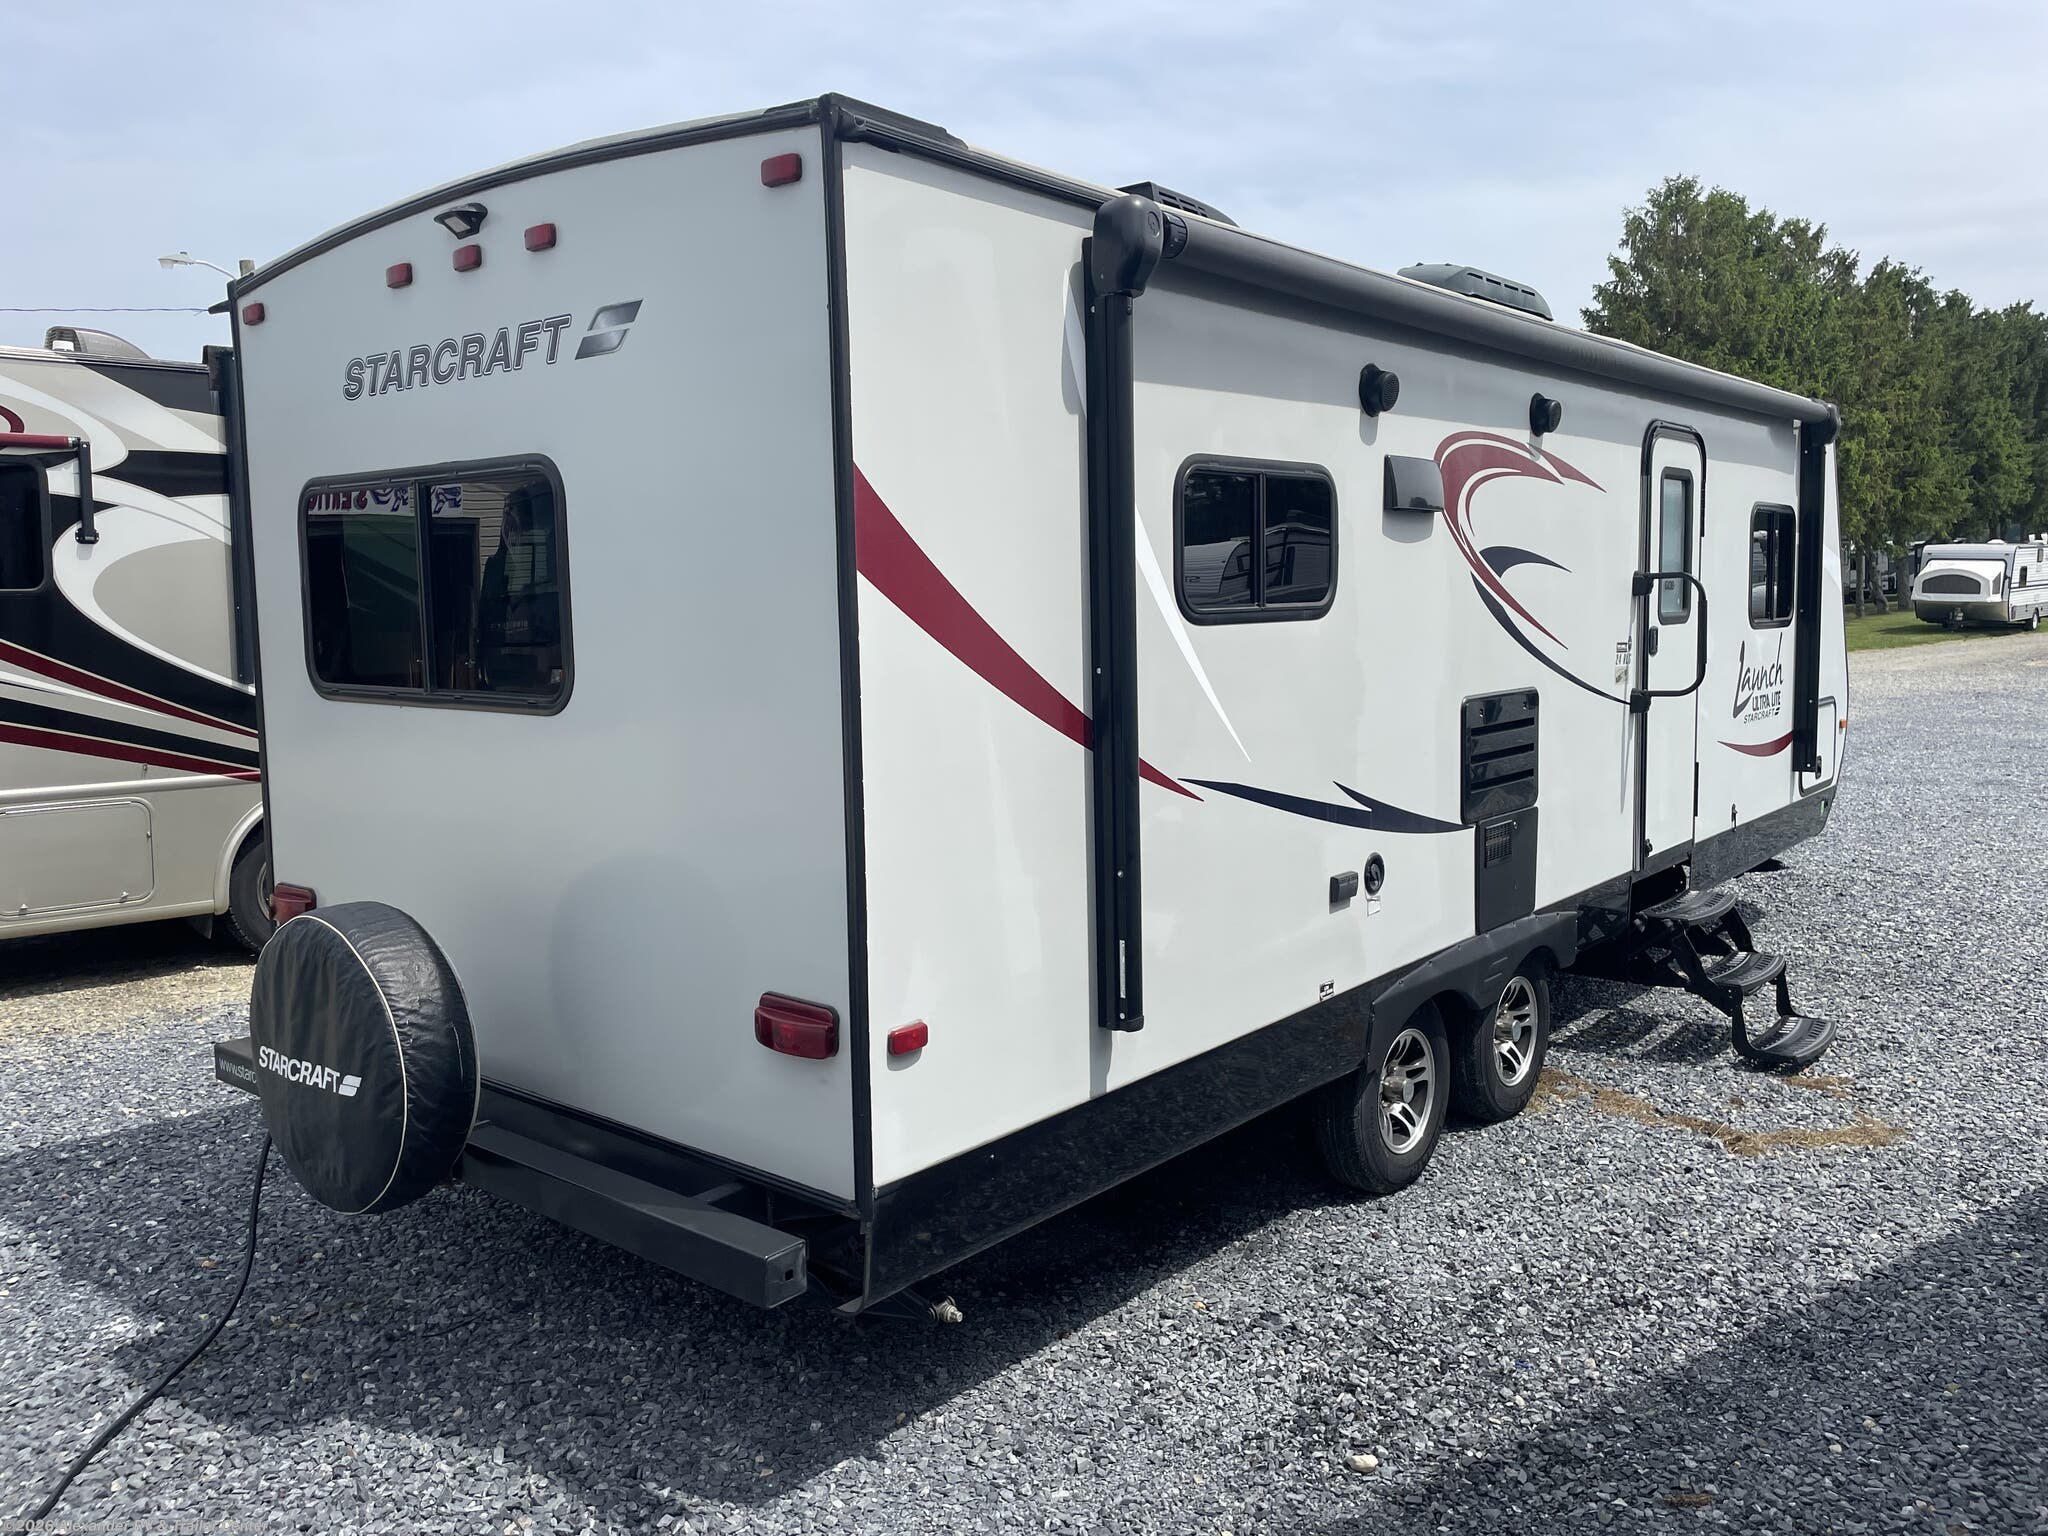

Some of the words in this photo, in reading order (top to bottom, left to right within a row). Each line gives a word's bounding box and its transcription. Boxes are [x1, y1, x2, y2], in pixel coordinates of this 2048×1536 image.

[343, 314, 572, 401] STARCRAFT
[1733, 632, 1783, 719] Launch
[1743, 708, 1775, 724] STARCRAFT
[1752, 693, 1770, 712] ULTRA
[1771, 690, 1781, 707] LITE
[258, 1045, 341, 1093] STARCRAFT
